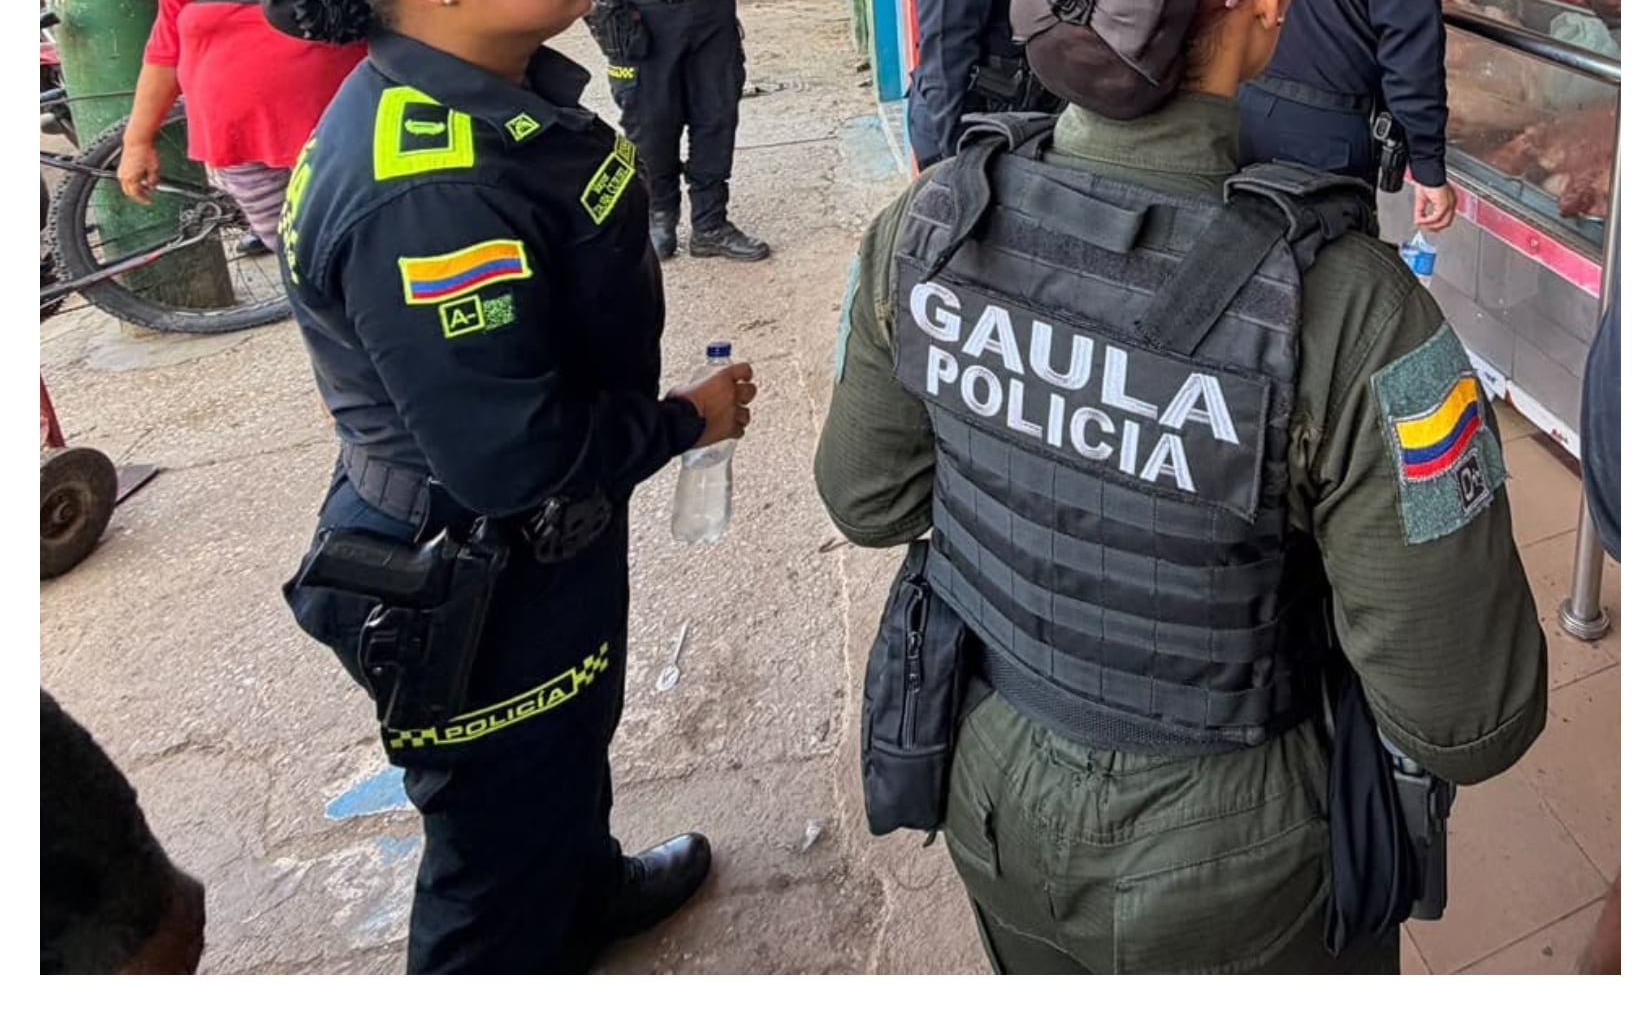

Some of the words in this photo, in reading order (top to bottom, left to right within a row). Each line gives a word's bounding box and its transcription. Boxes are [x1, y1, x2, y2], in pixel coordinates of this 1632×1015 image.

[910, 282, 1240, 445] GAULA
[926, 344, 1196, 493] POLICIA
[445, 687, 566, 739] POLICÍA
